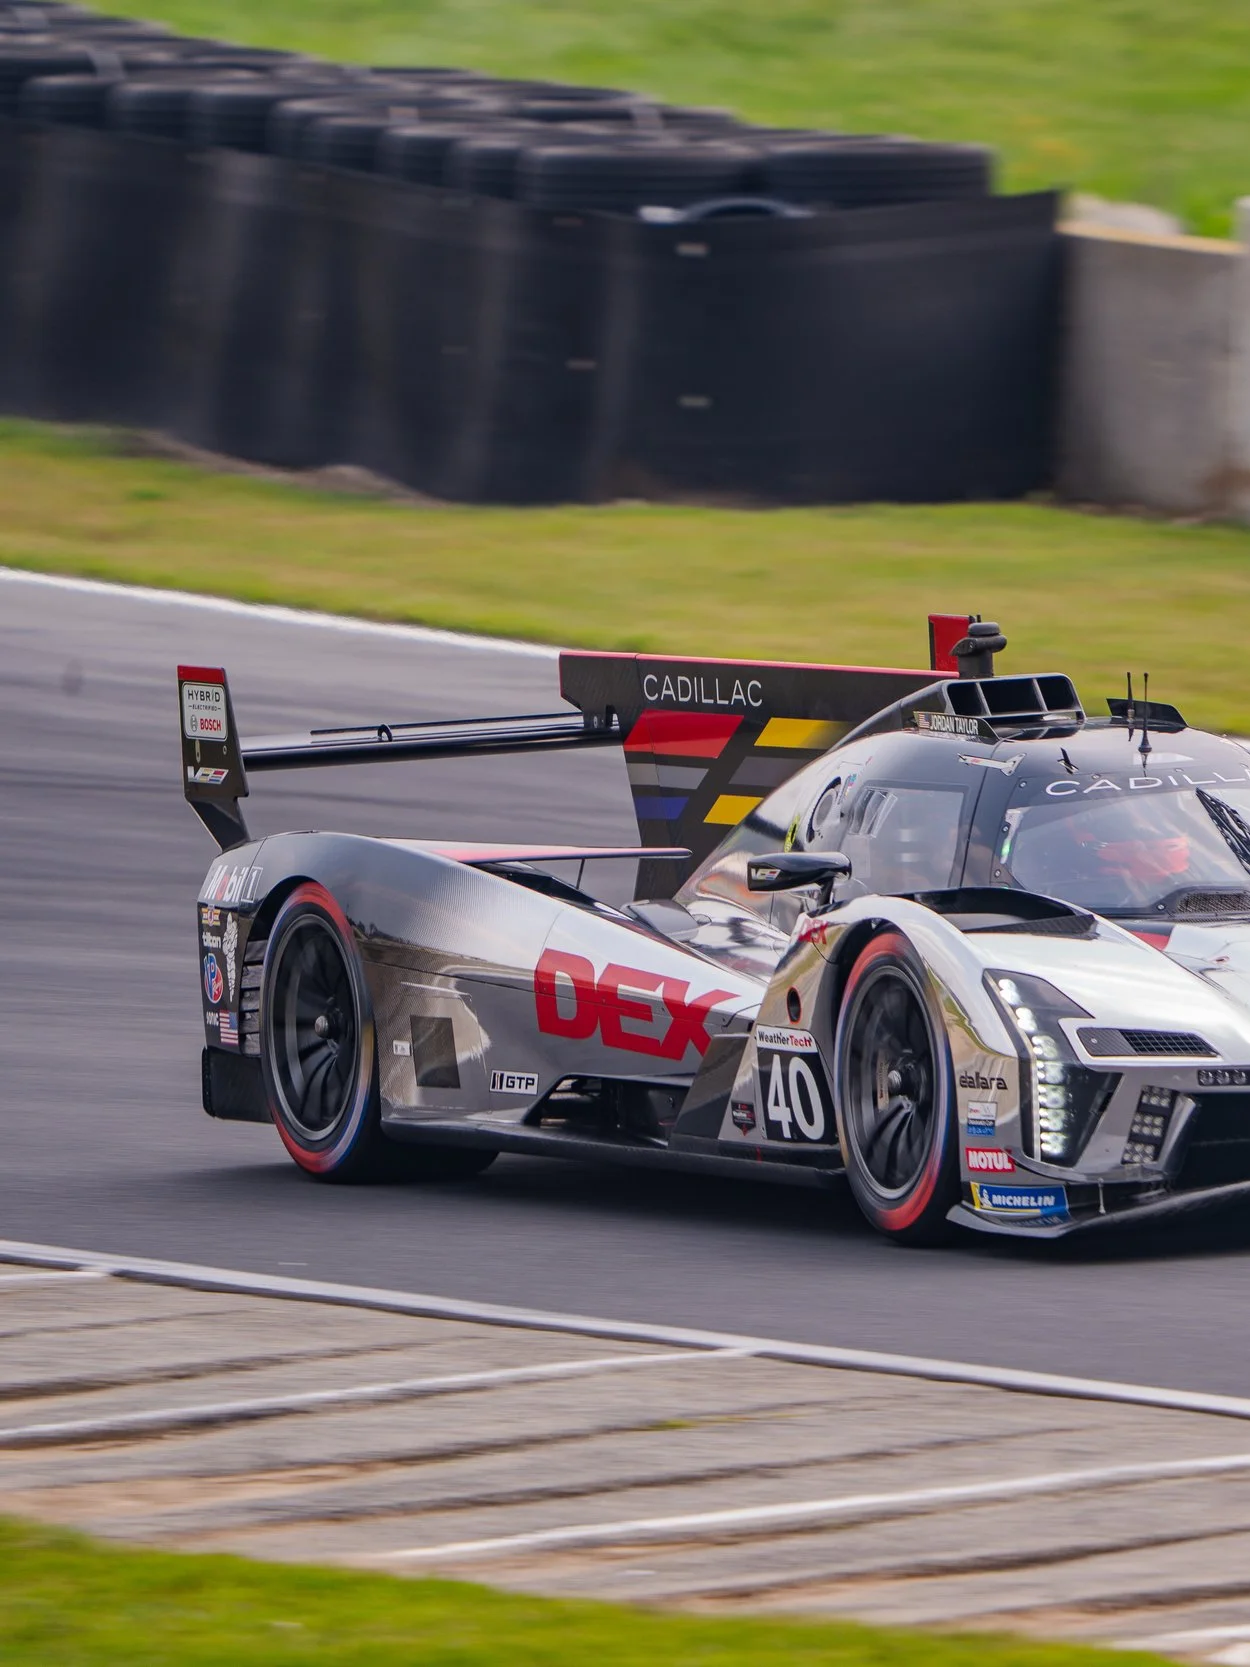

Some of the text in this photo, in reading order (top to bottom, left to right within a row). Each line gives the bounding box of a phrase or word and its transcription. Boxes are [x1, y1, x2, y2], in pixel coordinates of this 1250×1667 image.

[187, 689, 221, 702] HYBRID
[643, 674, 763, 707] CADILLAC
[200, 718, 221, 731] BOSCH
[930, 714, 979, 735] JORDAN TAYLOR
[204, 865, 249, 902] Mobil
[534, 947, 742, 1062] DEX
[758, 1031, 813, 1047] WeatherTech
[506, 1076, 535, 1090] GTP
[767, 1053, 825, 1140] 40
[968, 1150, 1013, 1170] MOTUL
[992, 1194, 1055, 1207] MICHELIN
